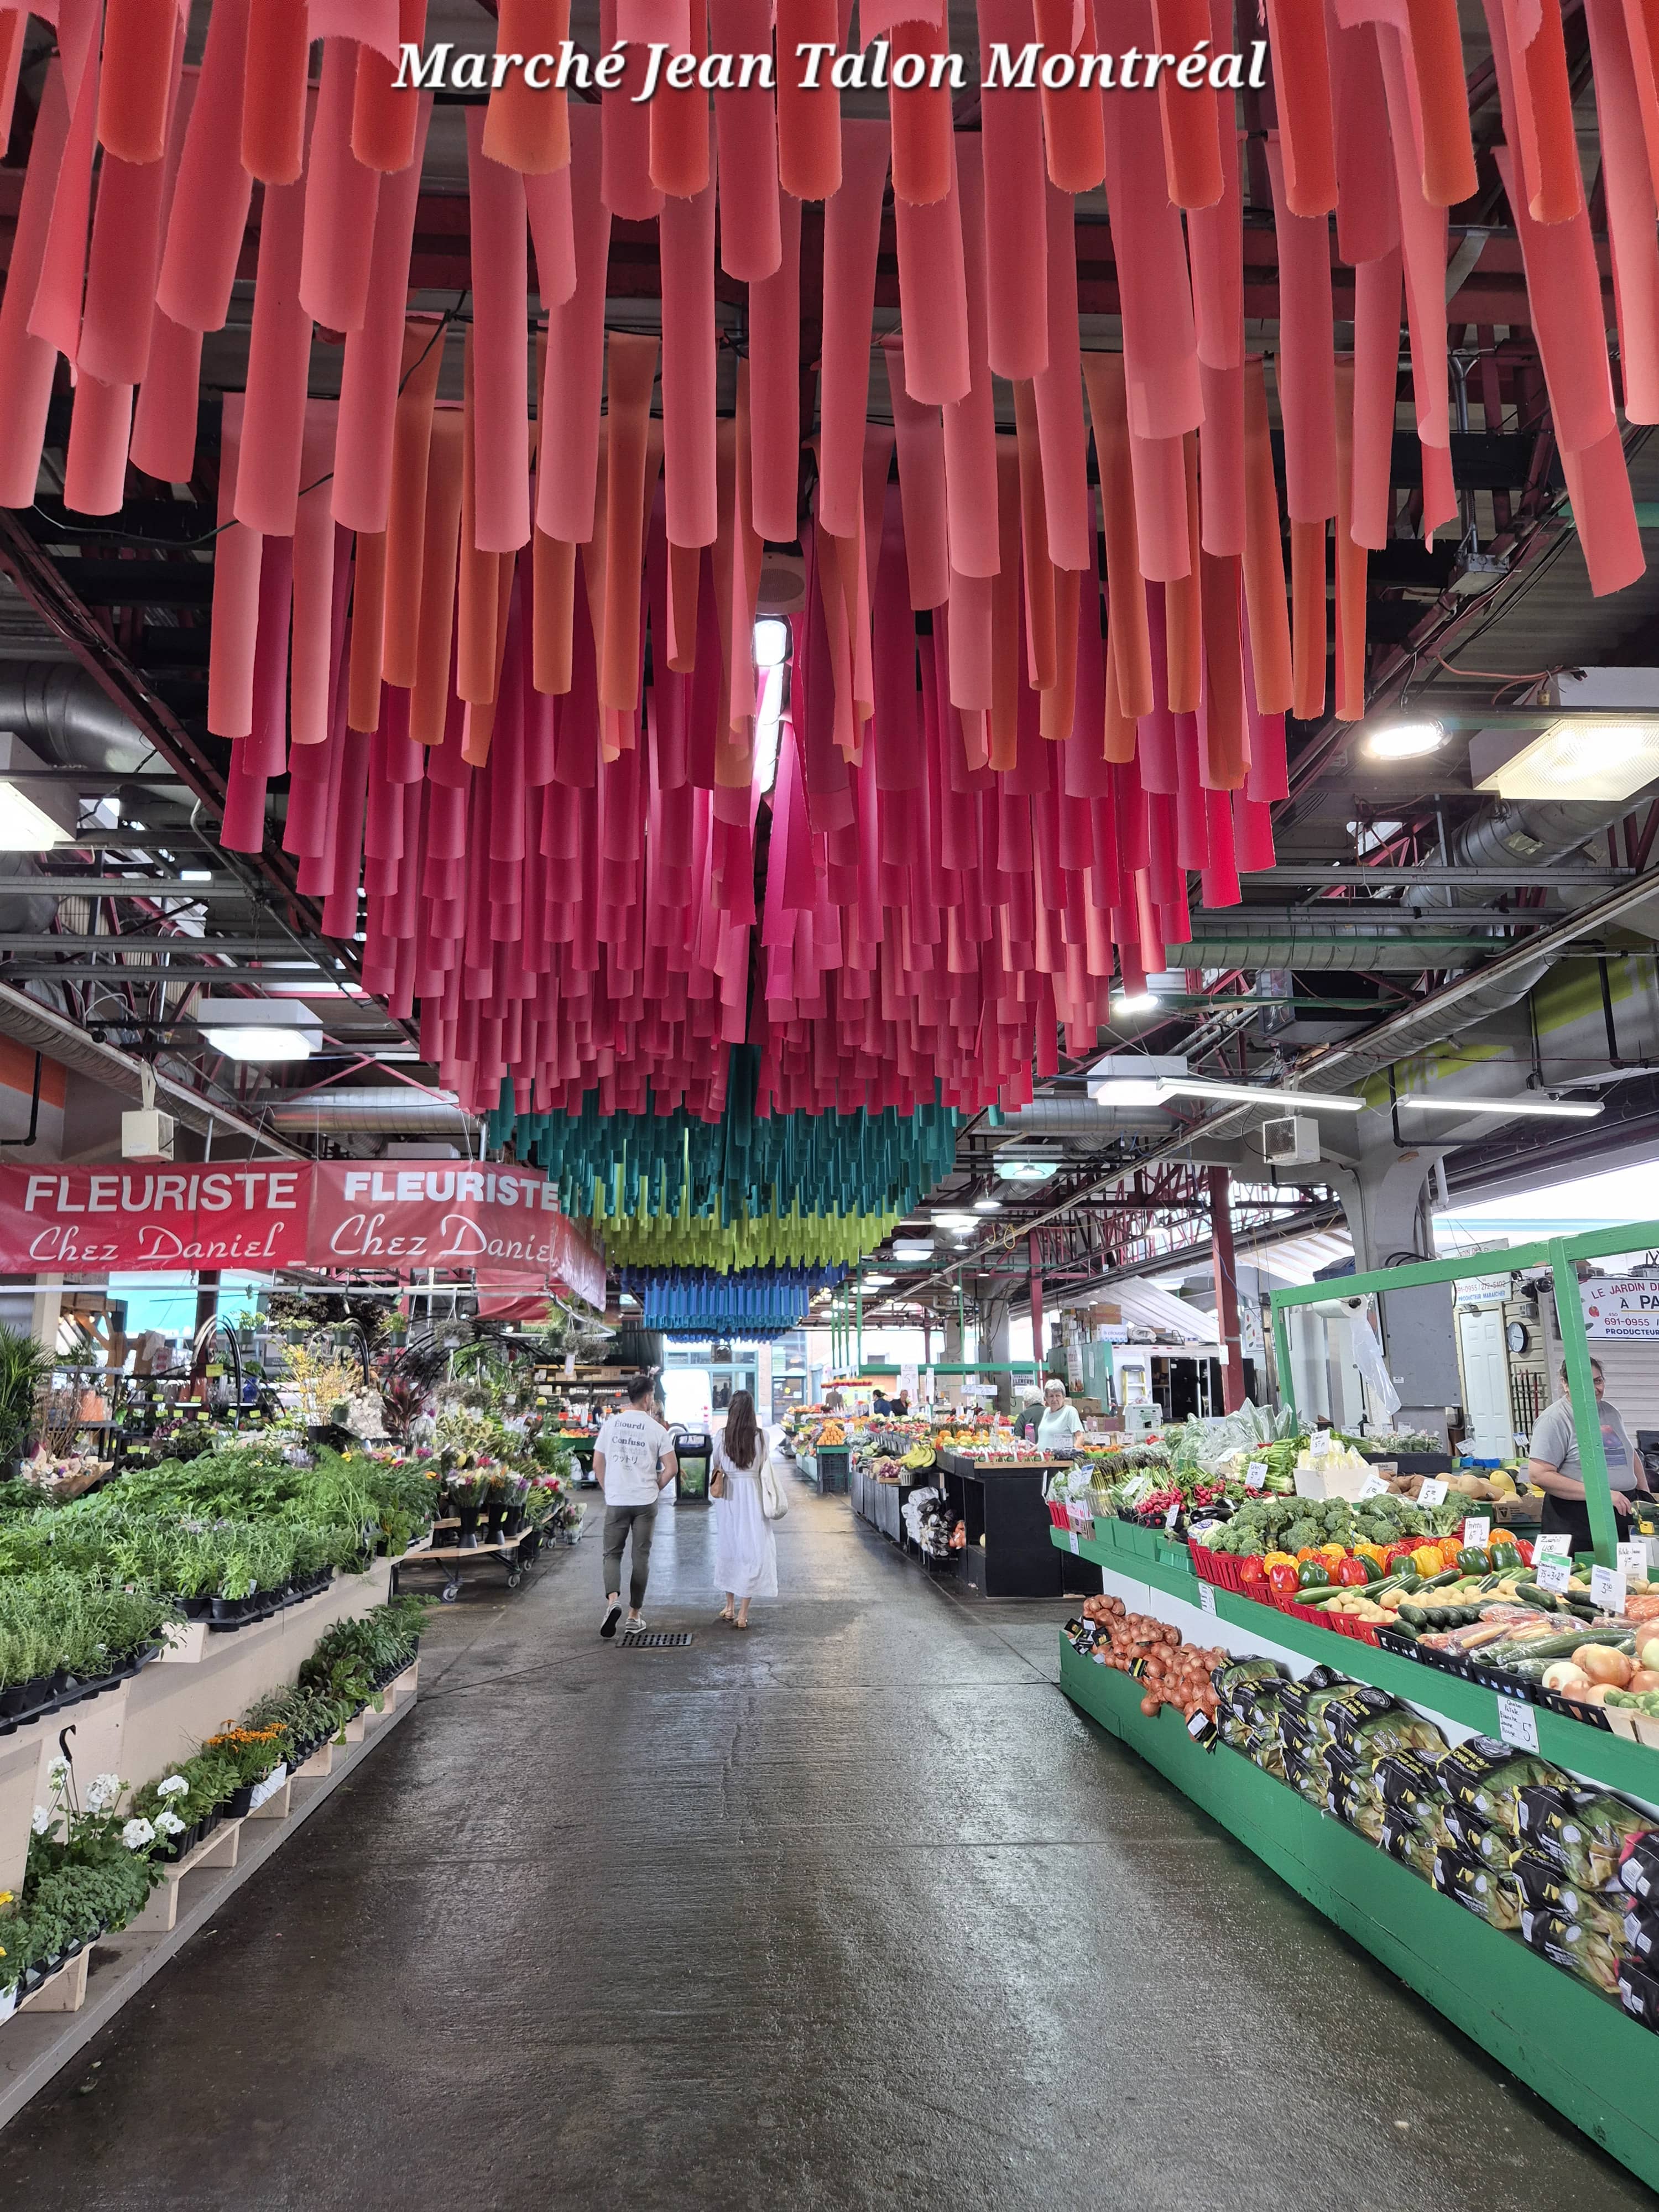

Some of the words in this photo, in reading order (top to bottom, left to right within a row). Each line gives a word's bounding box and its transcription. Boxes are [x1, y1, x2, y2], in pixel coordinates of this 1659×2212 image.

[24, 1172, 299, 1213] FLEURISTE
[344, 1171, 558, 1212] FLEURISTE
[29, 1225, 119, 1261] Chez
[137, 1222, 285, 1261] Daniel
[331, 1213, 427, 1256] Chez
[439, 1214, 559, 1263] Daniel
[1591, 1288, 1606, 1300] LE
[1610, 1282, 1645, 1295] JARDIN
[1620, 1297, 1629, 1309] À
[1604, 1317, 1650, 1326] 691-0955
[612, 1436, 645, 1447] Confuso
